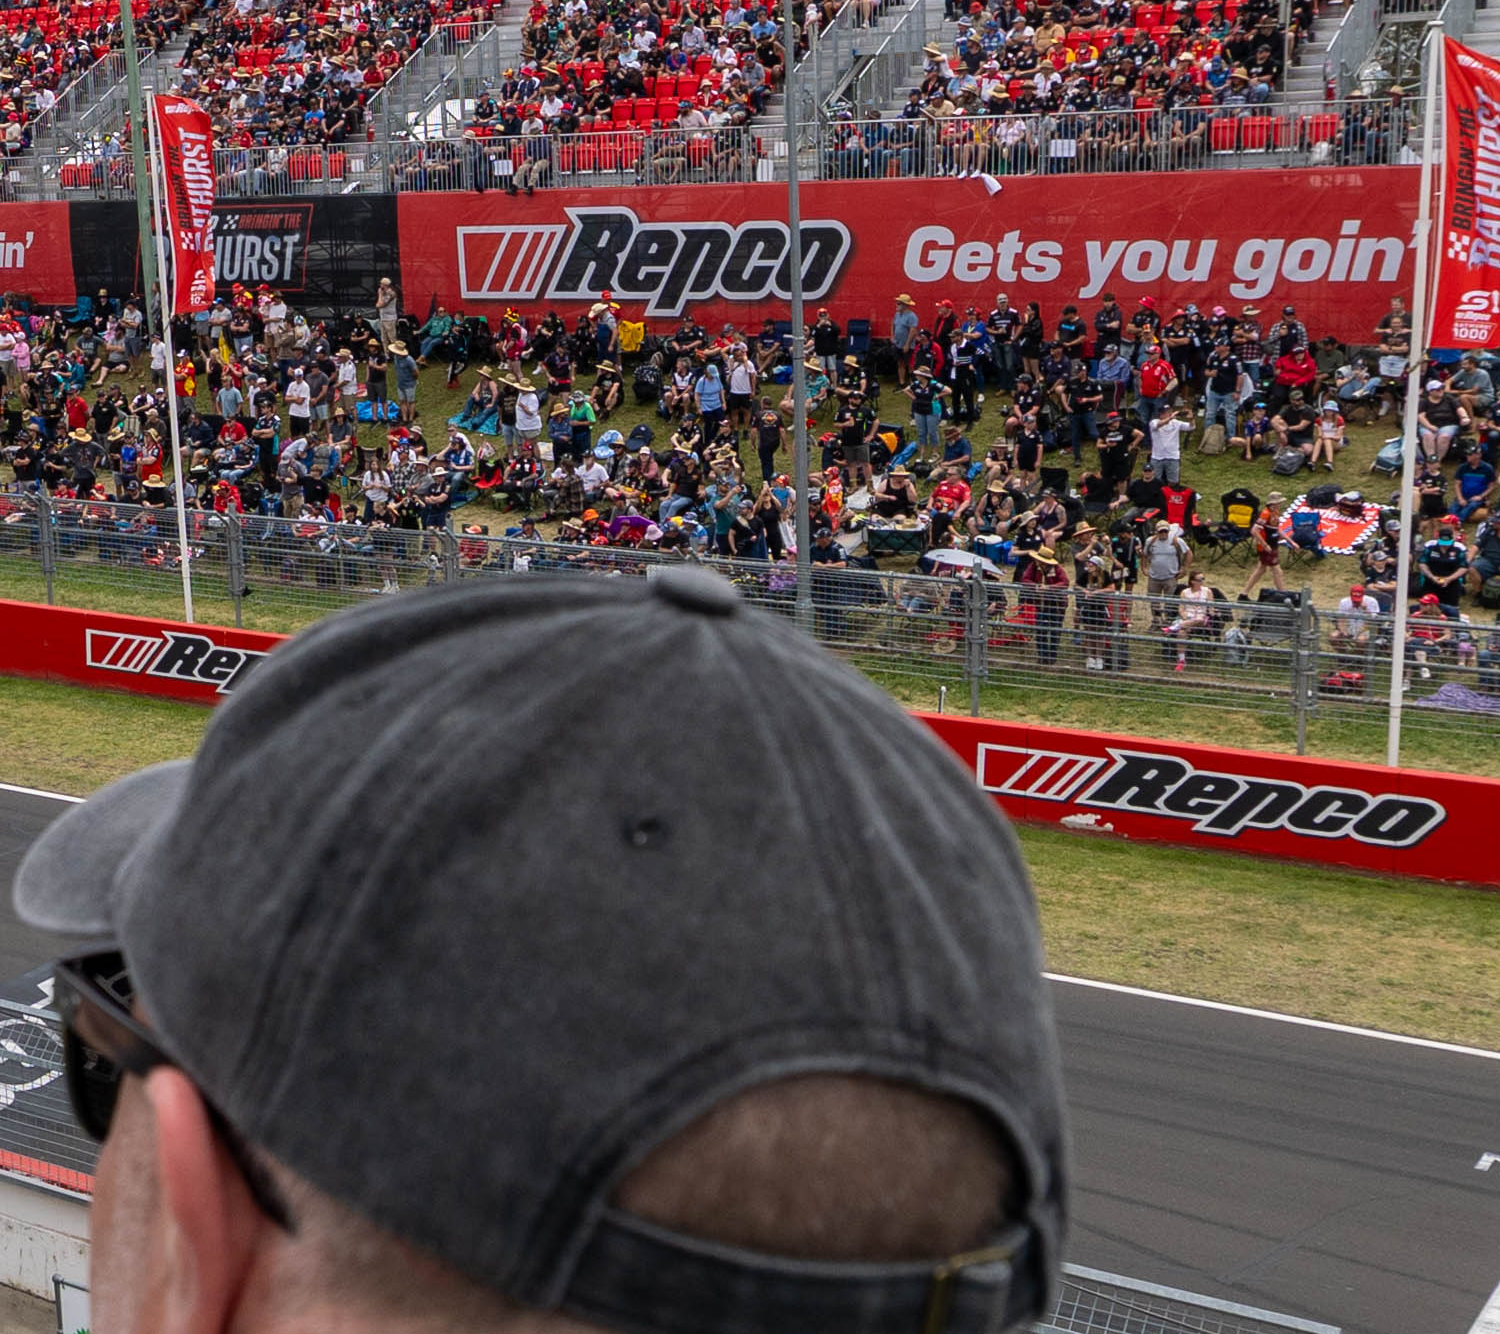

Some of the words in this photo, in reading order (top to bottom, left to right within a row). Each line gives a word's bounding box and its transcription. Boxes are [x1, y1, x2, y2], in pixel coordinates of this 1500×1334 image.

[545, 206, 854, 319] Repco
[904, 224, 1062, 286] Gets
[1079, 241, 1217, 299] you
[1231, 219, 1431, 300] goin'
[1453, 329, 1488, 340] 1000
[1075, 747, 1448, 848] Repco
